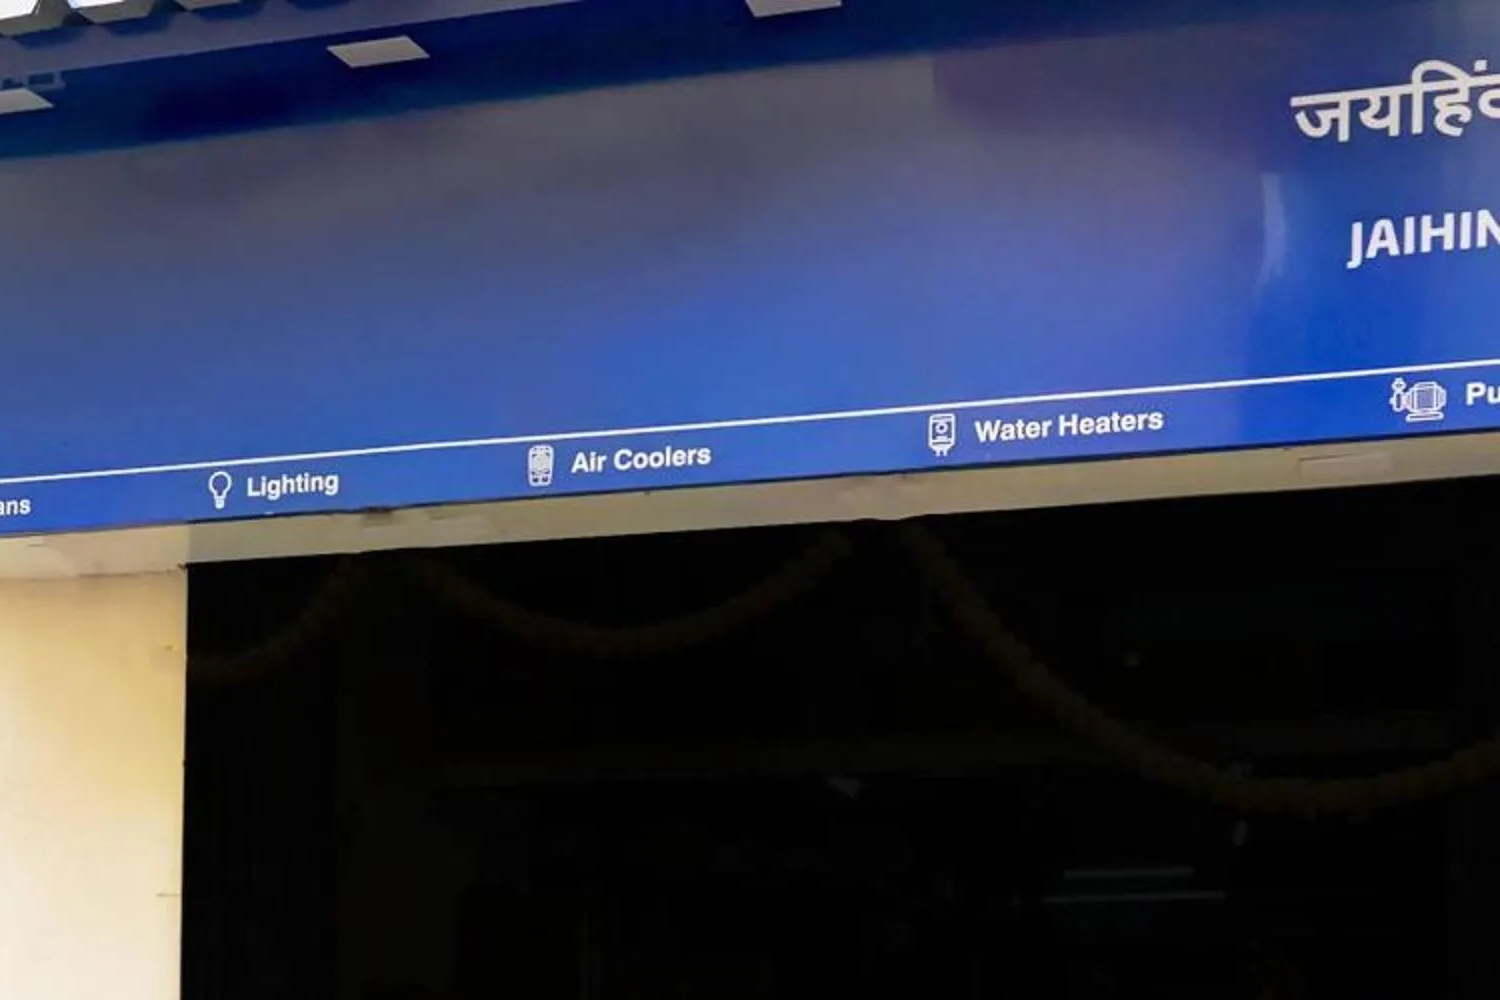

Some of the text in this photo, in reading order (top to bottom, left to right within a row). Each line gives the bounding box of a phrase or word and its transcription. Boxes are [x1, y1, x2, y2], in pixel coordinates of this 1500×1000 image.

[974, 411, 1164, 443] Water Heaters
[571, 446, 711, 473] Air Coolers
[247, 472, 339, 501] Lighting
